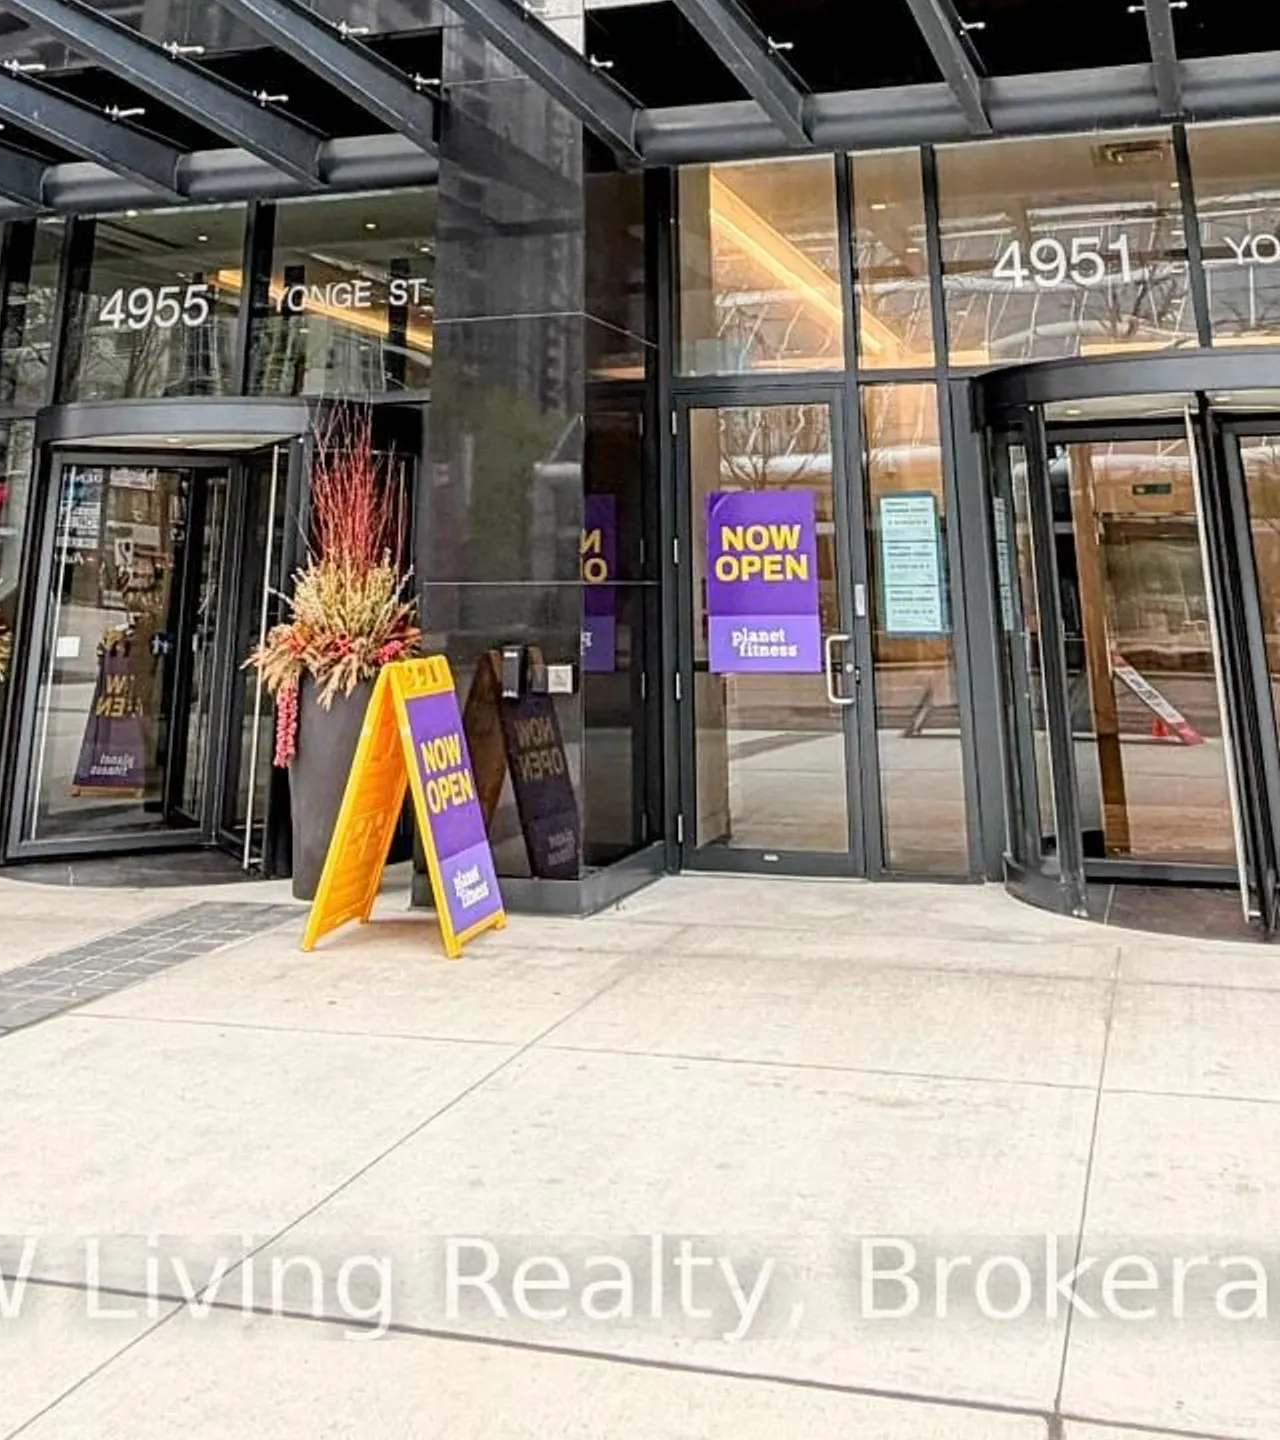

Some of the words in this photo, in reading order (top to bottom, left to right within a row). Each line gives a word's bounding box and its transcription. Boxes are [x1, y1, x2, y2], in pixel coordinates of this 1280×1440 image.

[992, 233, 1132, 288] 4951
[99, 284, 209, 330] 4955
[272, 279, 372, 313] YONGE
[389, 278, 427, 306] ST
[721, 524, 801, 552] NOW
[715, 554, 809, 582] OPEN
[732, 627, 786, 647] planet
[739, 642, 798, 658] fitness
[420, 733, 461, 774] NOW
[426, 769, 474, 814] OPEN
